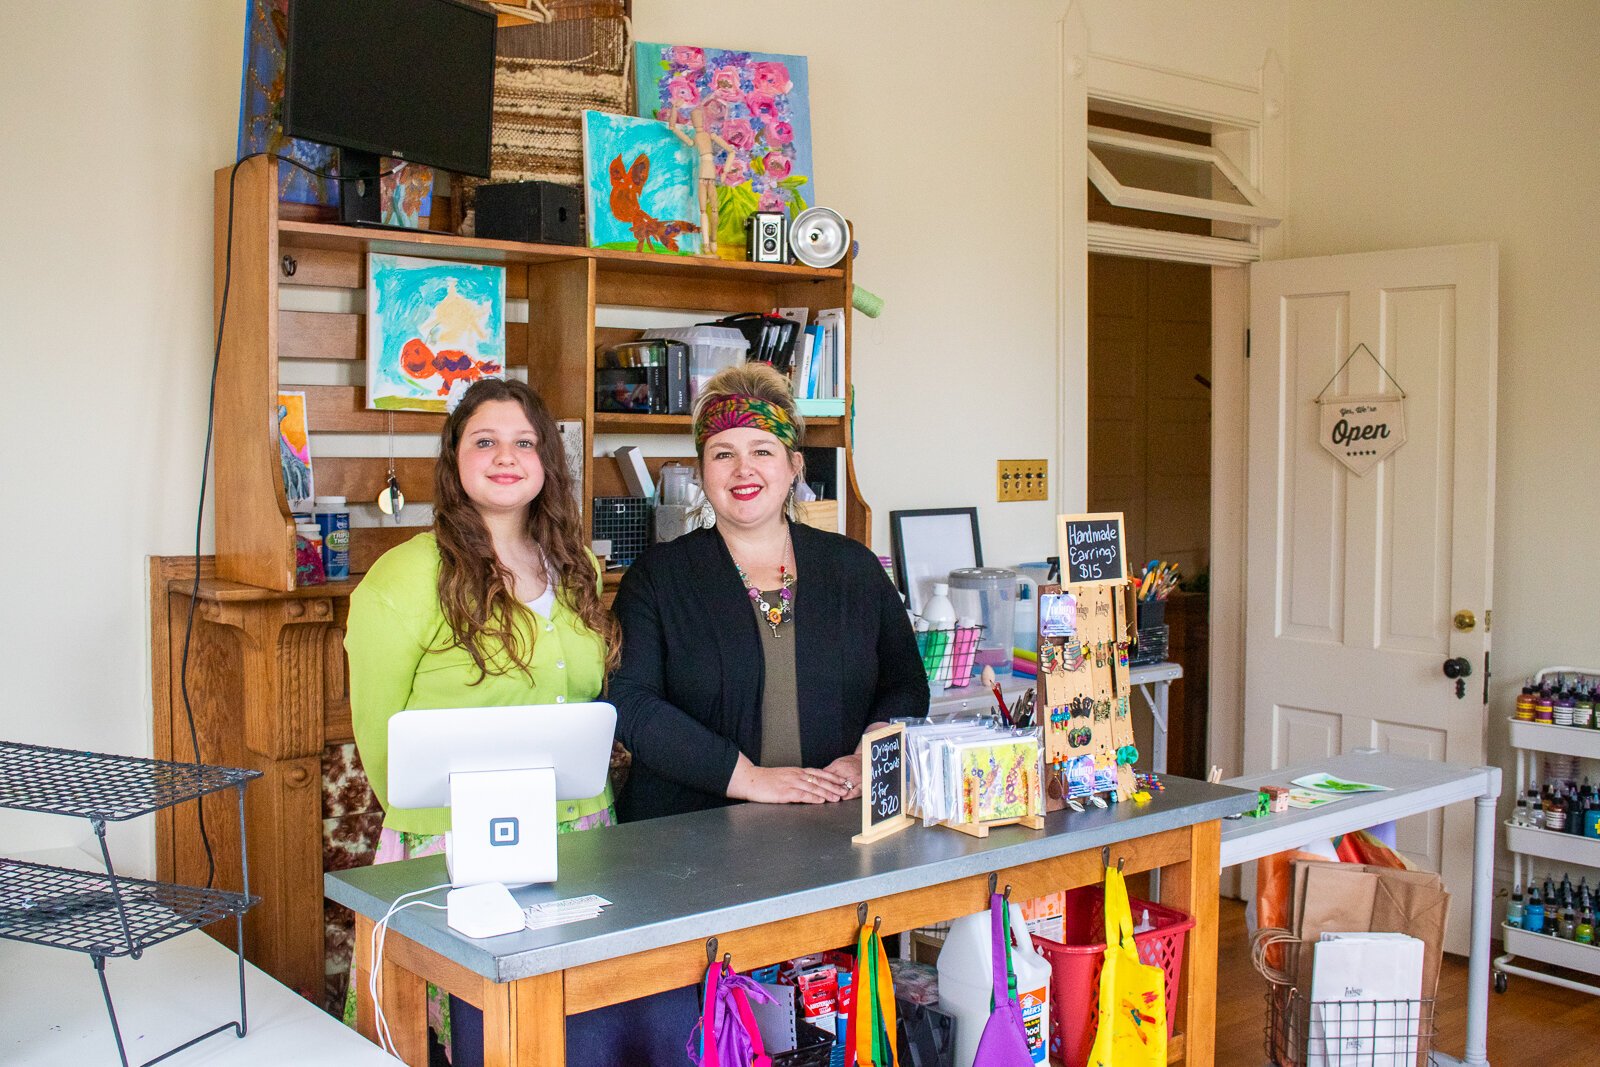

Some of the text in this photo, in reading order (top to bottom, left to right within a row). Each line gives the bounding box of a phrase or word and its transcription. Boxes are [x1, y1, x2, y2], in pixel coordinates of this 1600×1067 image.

[1332, 419, 1390, 446] Open
[1068, 524, 1117, 545] Handmade
[1069, 545, 1117, 565] Earrings
[1079, 563, 1103, 580] $15
[871, 739, 899, 761] Original
[883, 757, 900, 774] Cards
[871, 782, 889, 806] 5 for
[877, 795, 899, 817] $20
